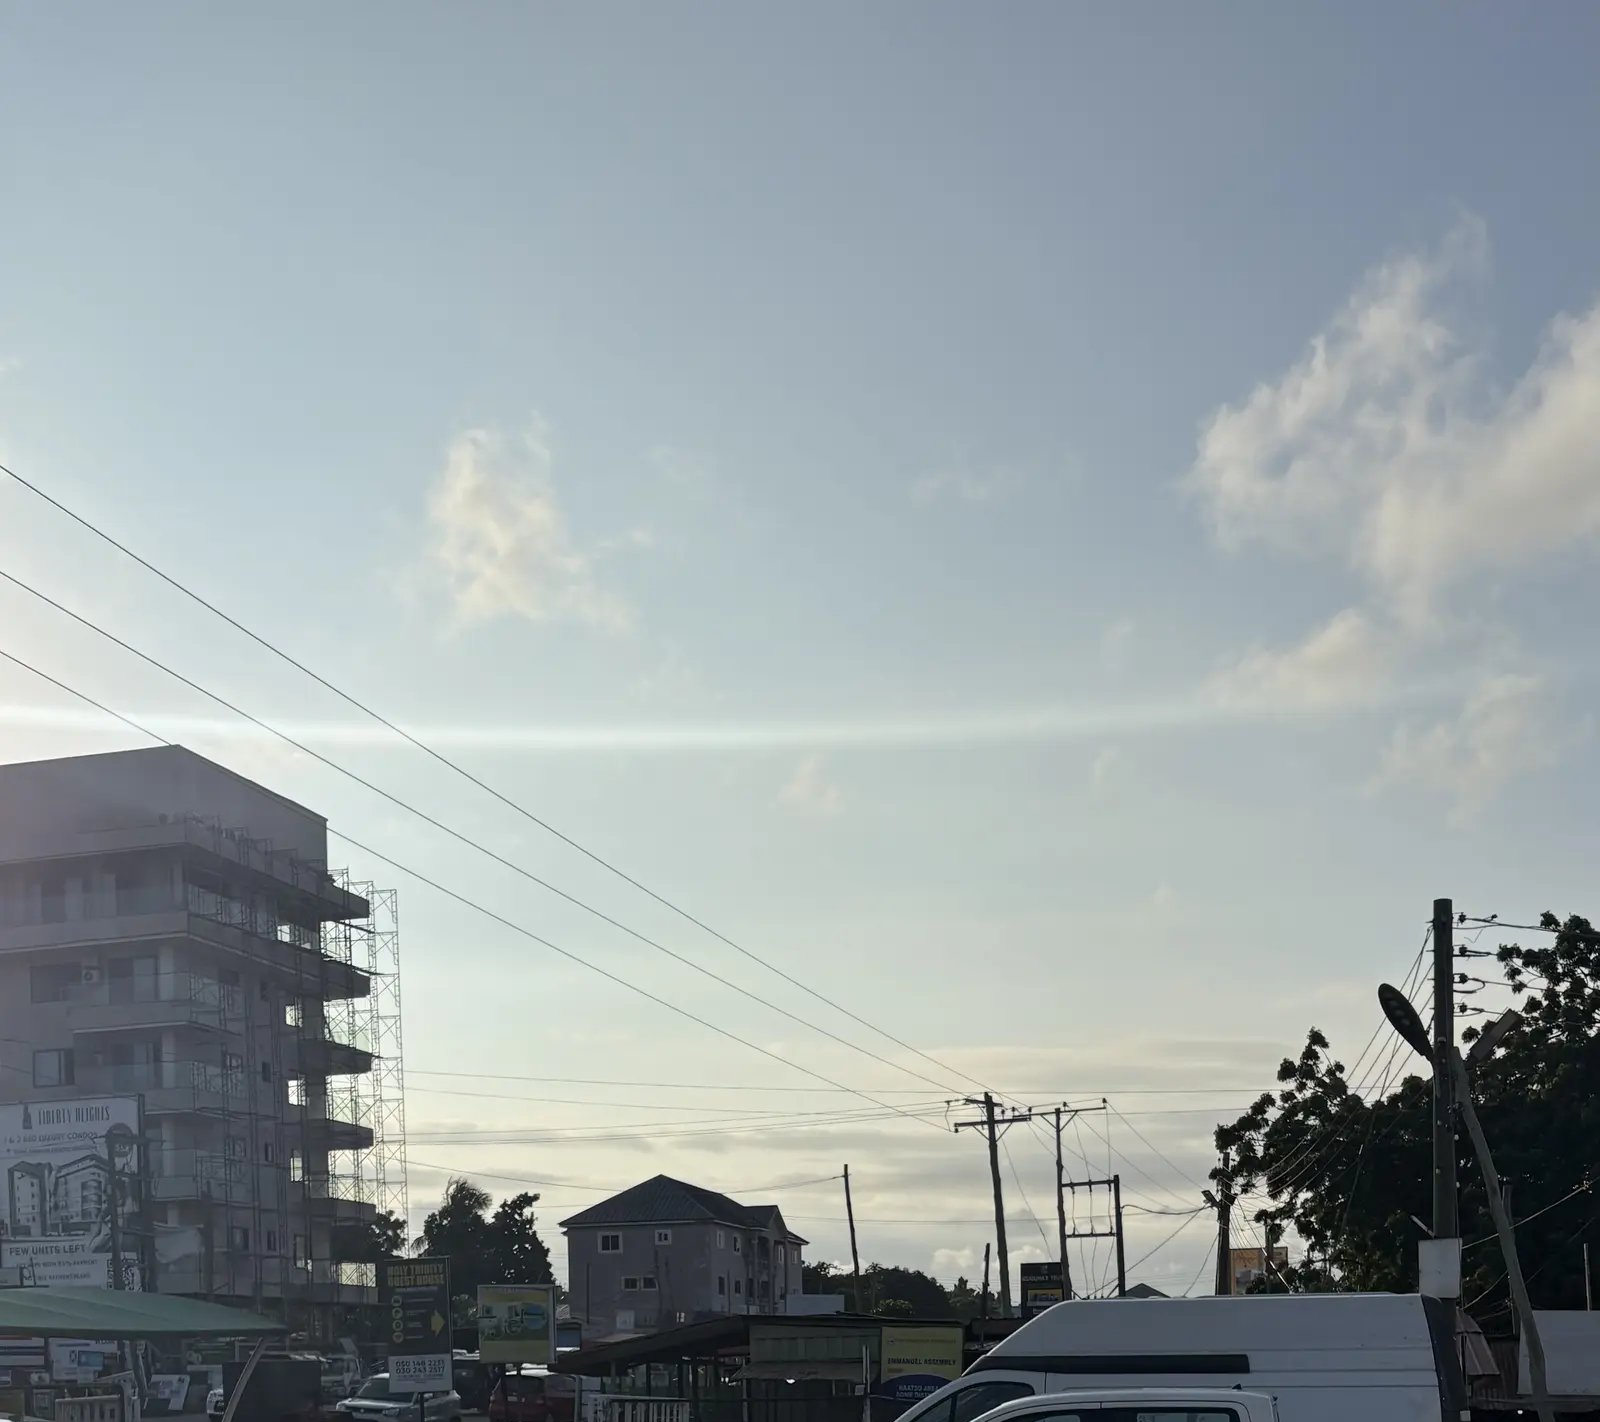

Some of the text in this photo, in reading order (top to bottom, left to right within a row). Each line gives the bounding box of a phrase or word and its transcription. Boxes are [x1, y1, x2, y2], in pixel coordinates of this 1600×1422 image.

[75, 1105, 110, 1122] HEIGHTS
[9, 1243, 86, 1256] FEW UNITS LEFT
[387, 1265, 408, 1276] HOLY
[887, 1357, 957, 1366] EMMANUEL ASSEMBLY
